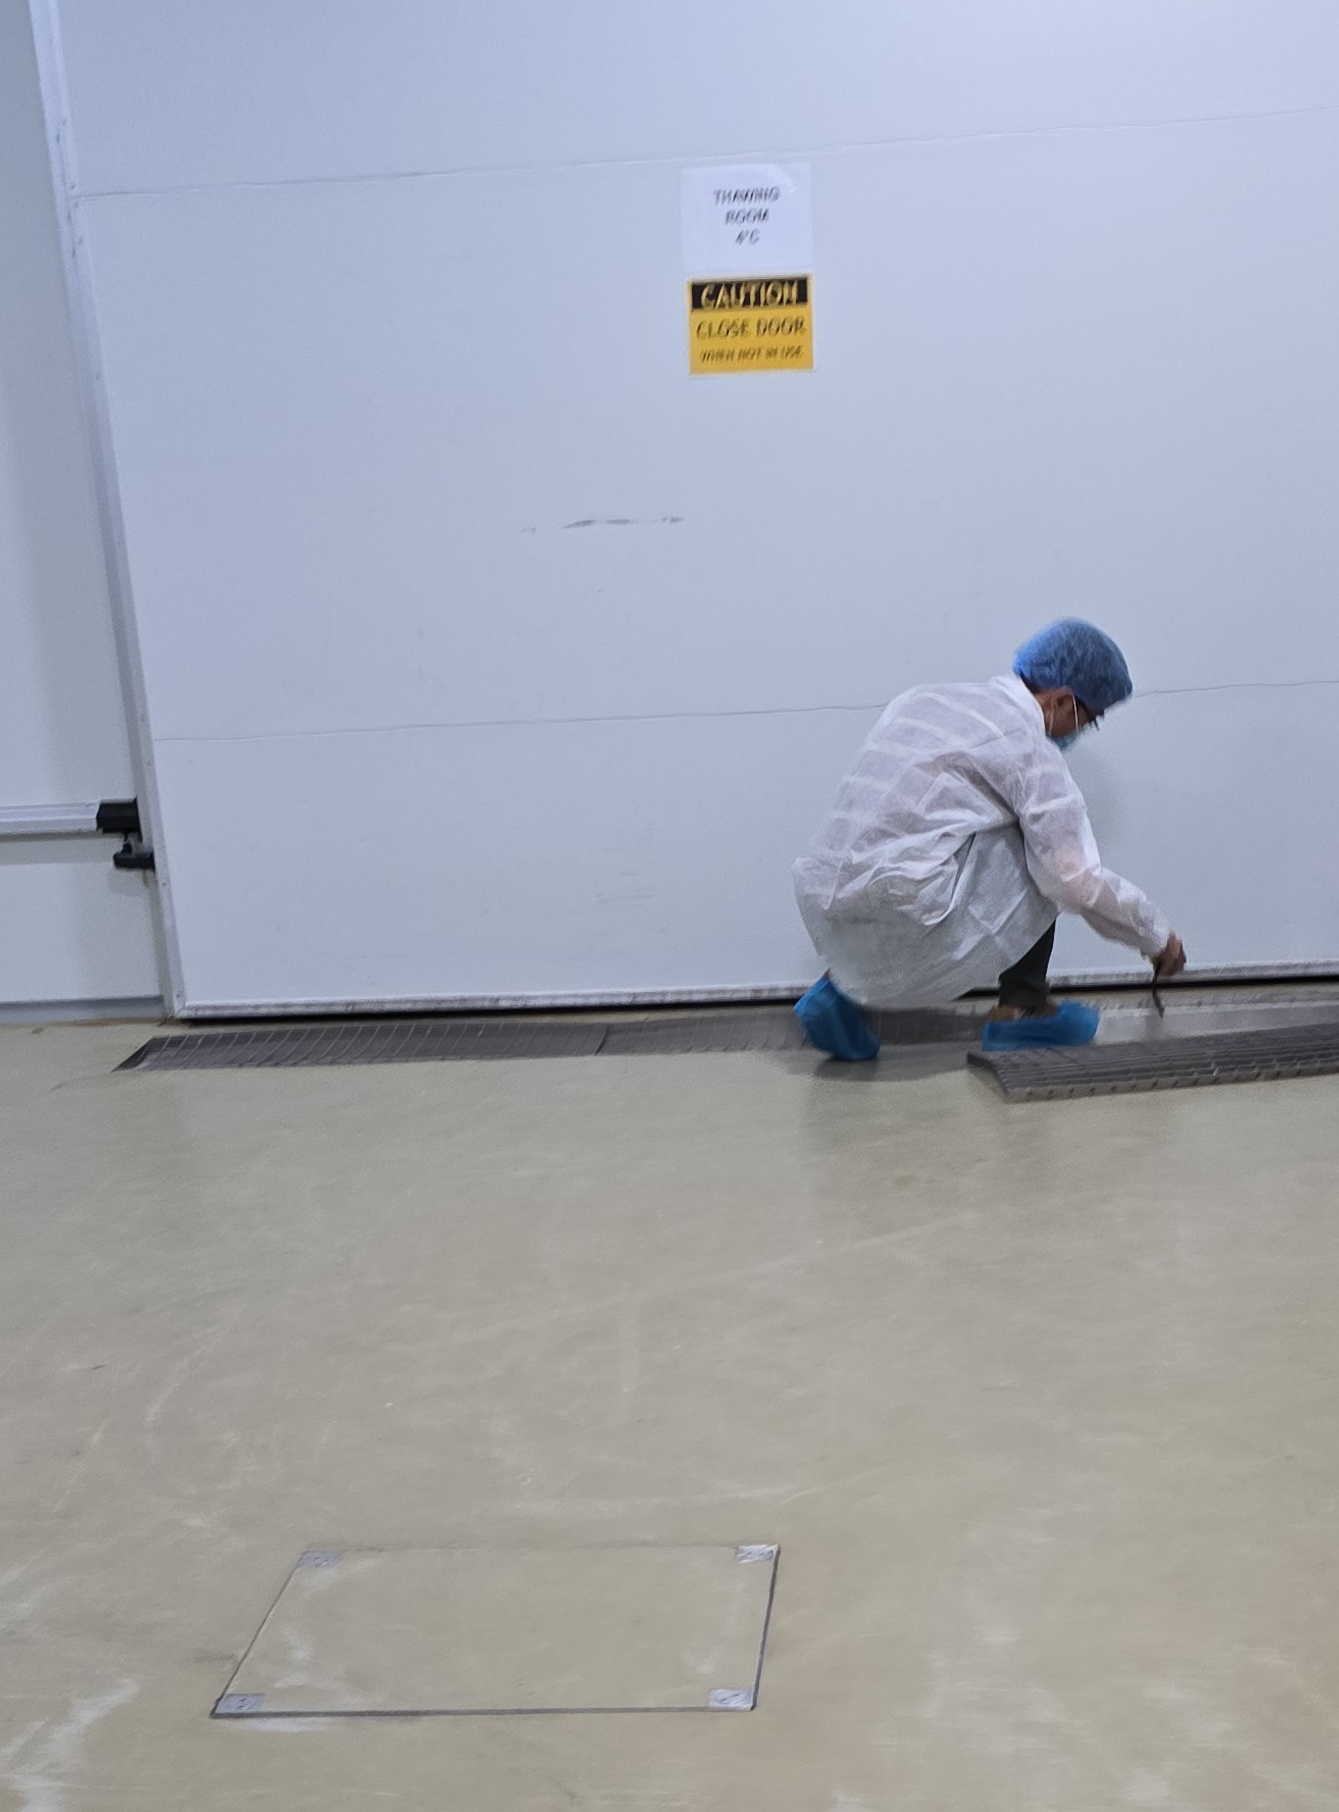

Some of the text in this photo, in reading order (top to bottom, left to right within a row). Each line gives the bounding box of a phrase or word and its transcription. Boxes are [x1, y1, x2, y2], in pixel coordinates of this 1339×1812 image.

[713, 186, 780, 205] THAWING
[725, 208, 769, 225] ROOM
[702, 280, 798, 309] CAUTION
[696, 316, 806, 339] CLOSE DOOR
